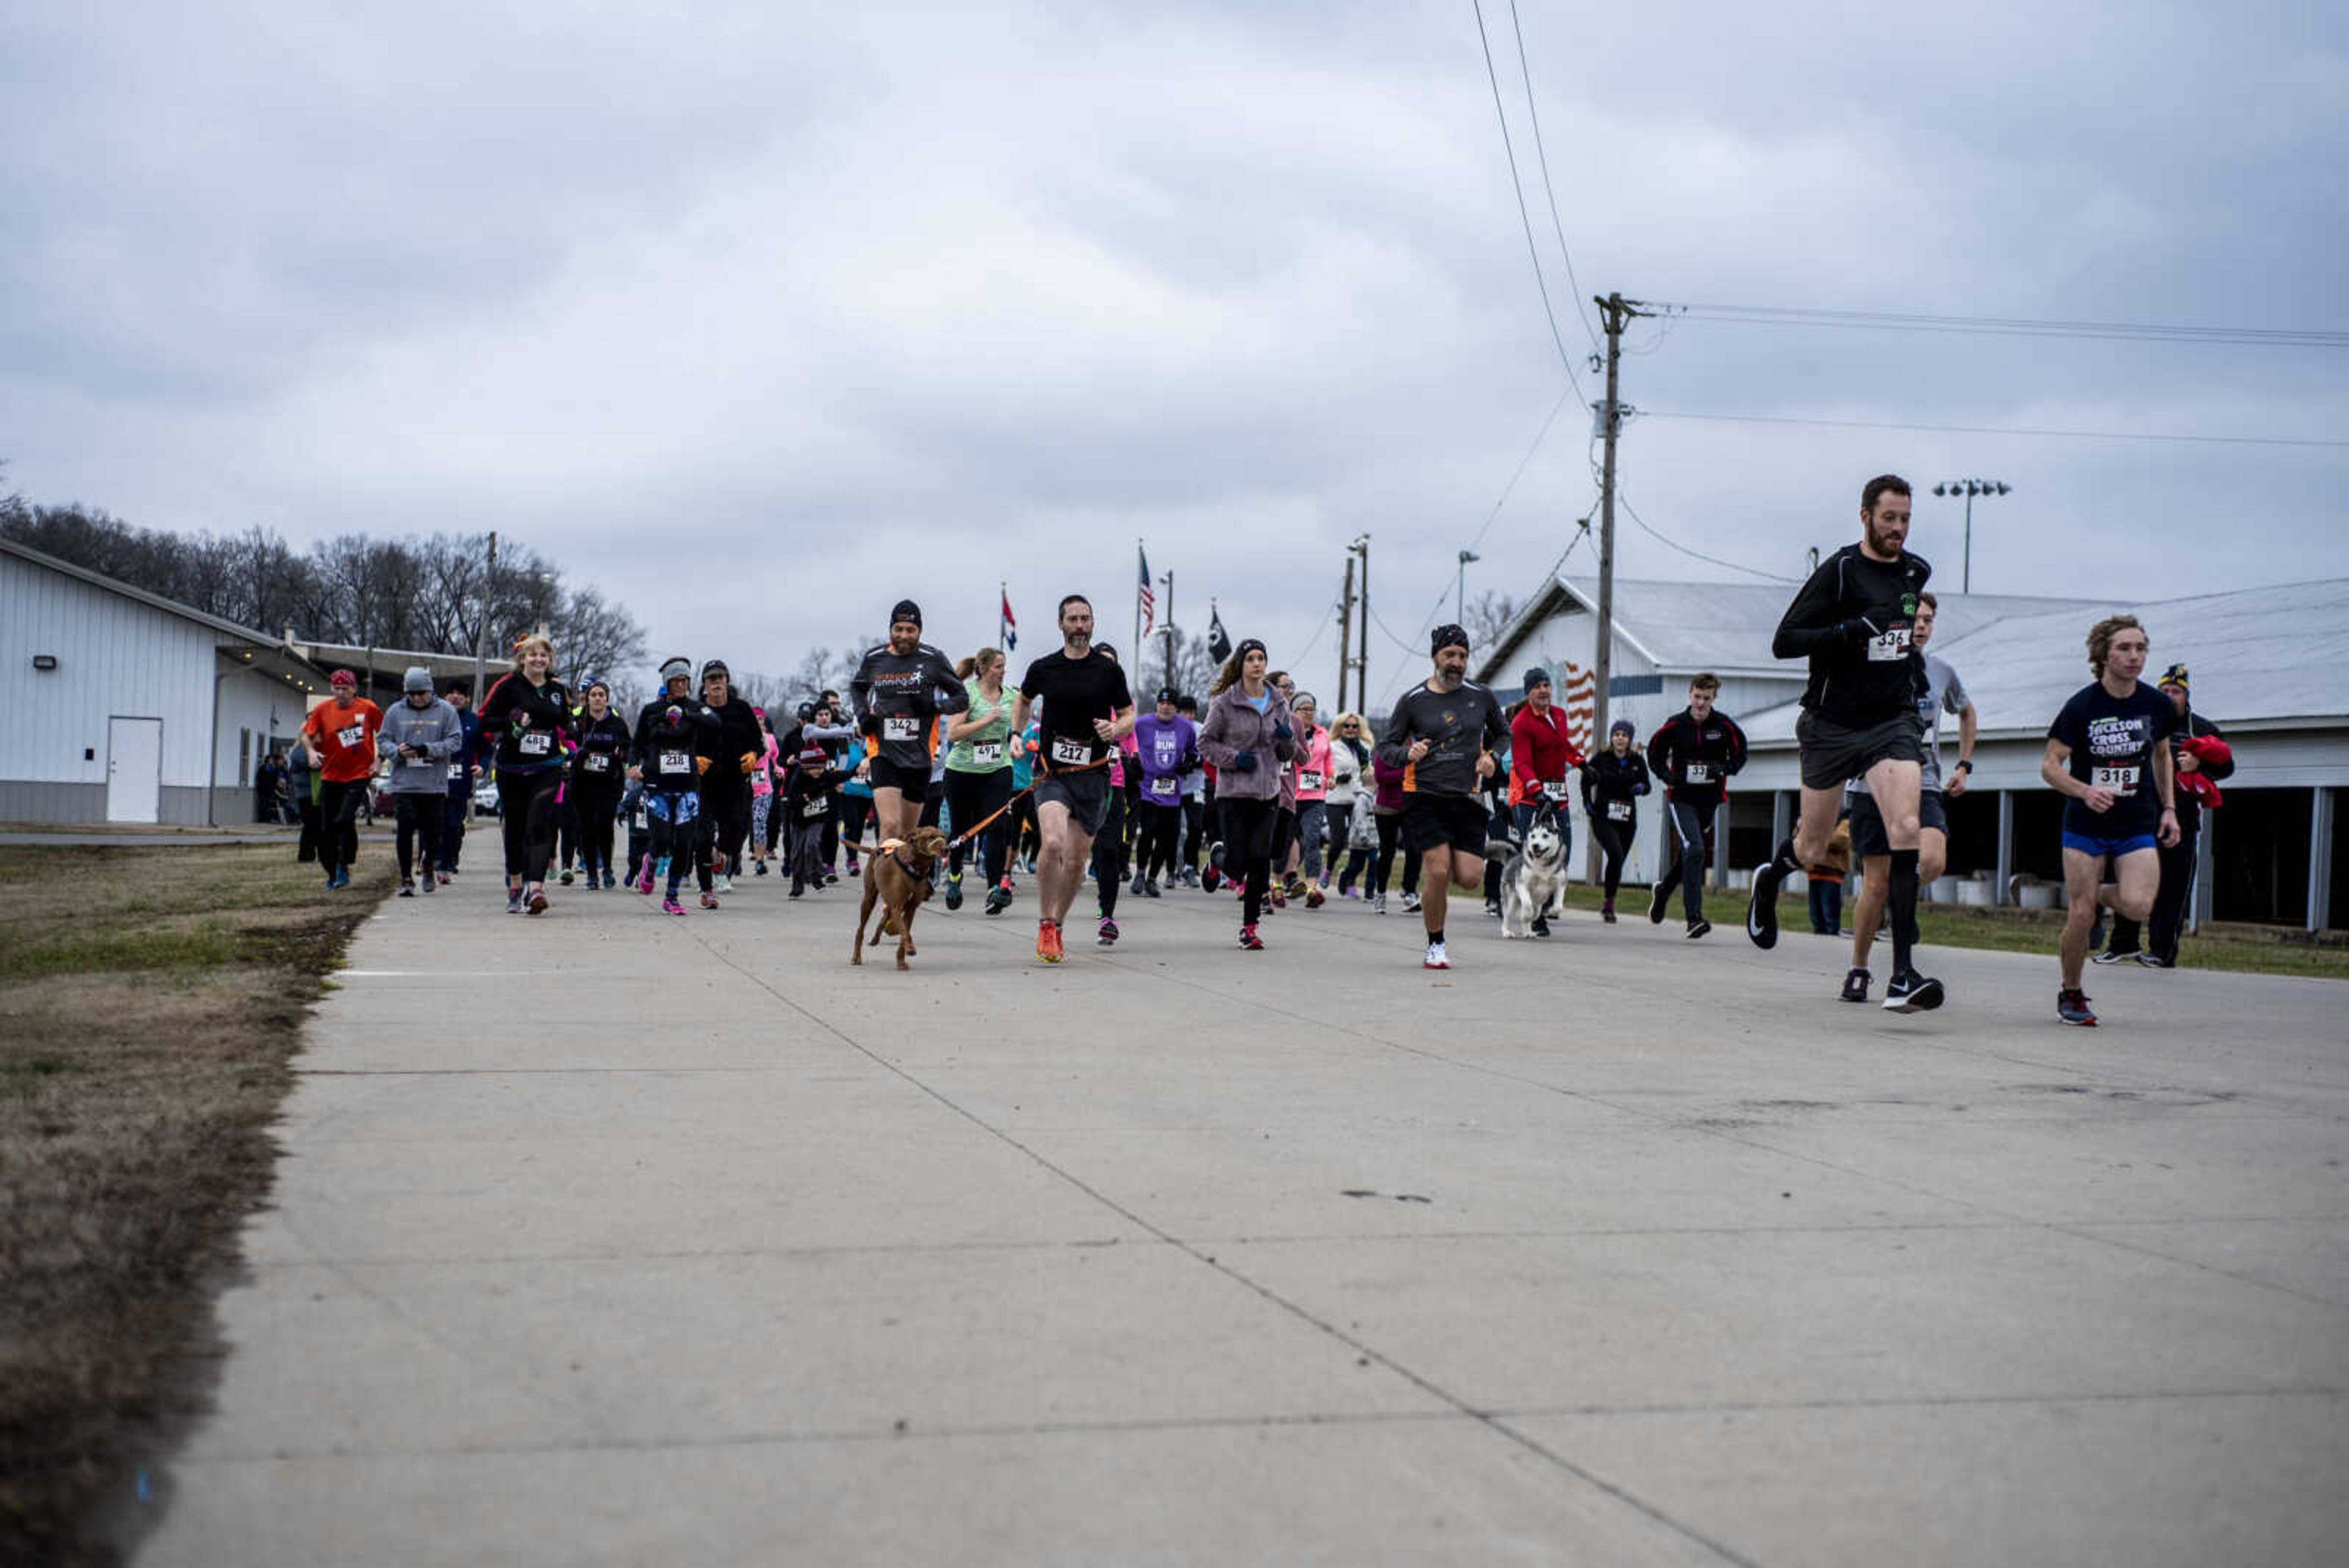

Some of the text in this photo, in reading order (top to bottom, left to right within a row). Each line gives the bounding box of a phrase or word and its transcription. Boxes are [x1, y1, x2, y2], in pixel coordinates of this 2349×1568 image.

[1877, 631, 1904, 647] 336
[2088, 719, 2143, 738] JACKSON
[2092, 732, 2130, 746] CROSS
[1059, 745, 1084, 760] 217
[2090, 740, 2145, 754] COUNTRY
[666, 754, 684, 765] 218
[2101, 770, 2132, 783] 318
